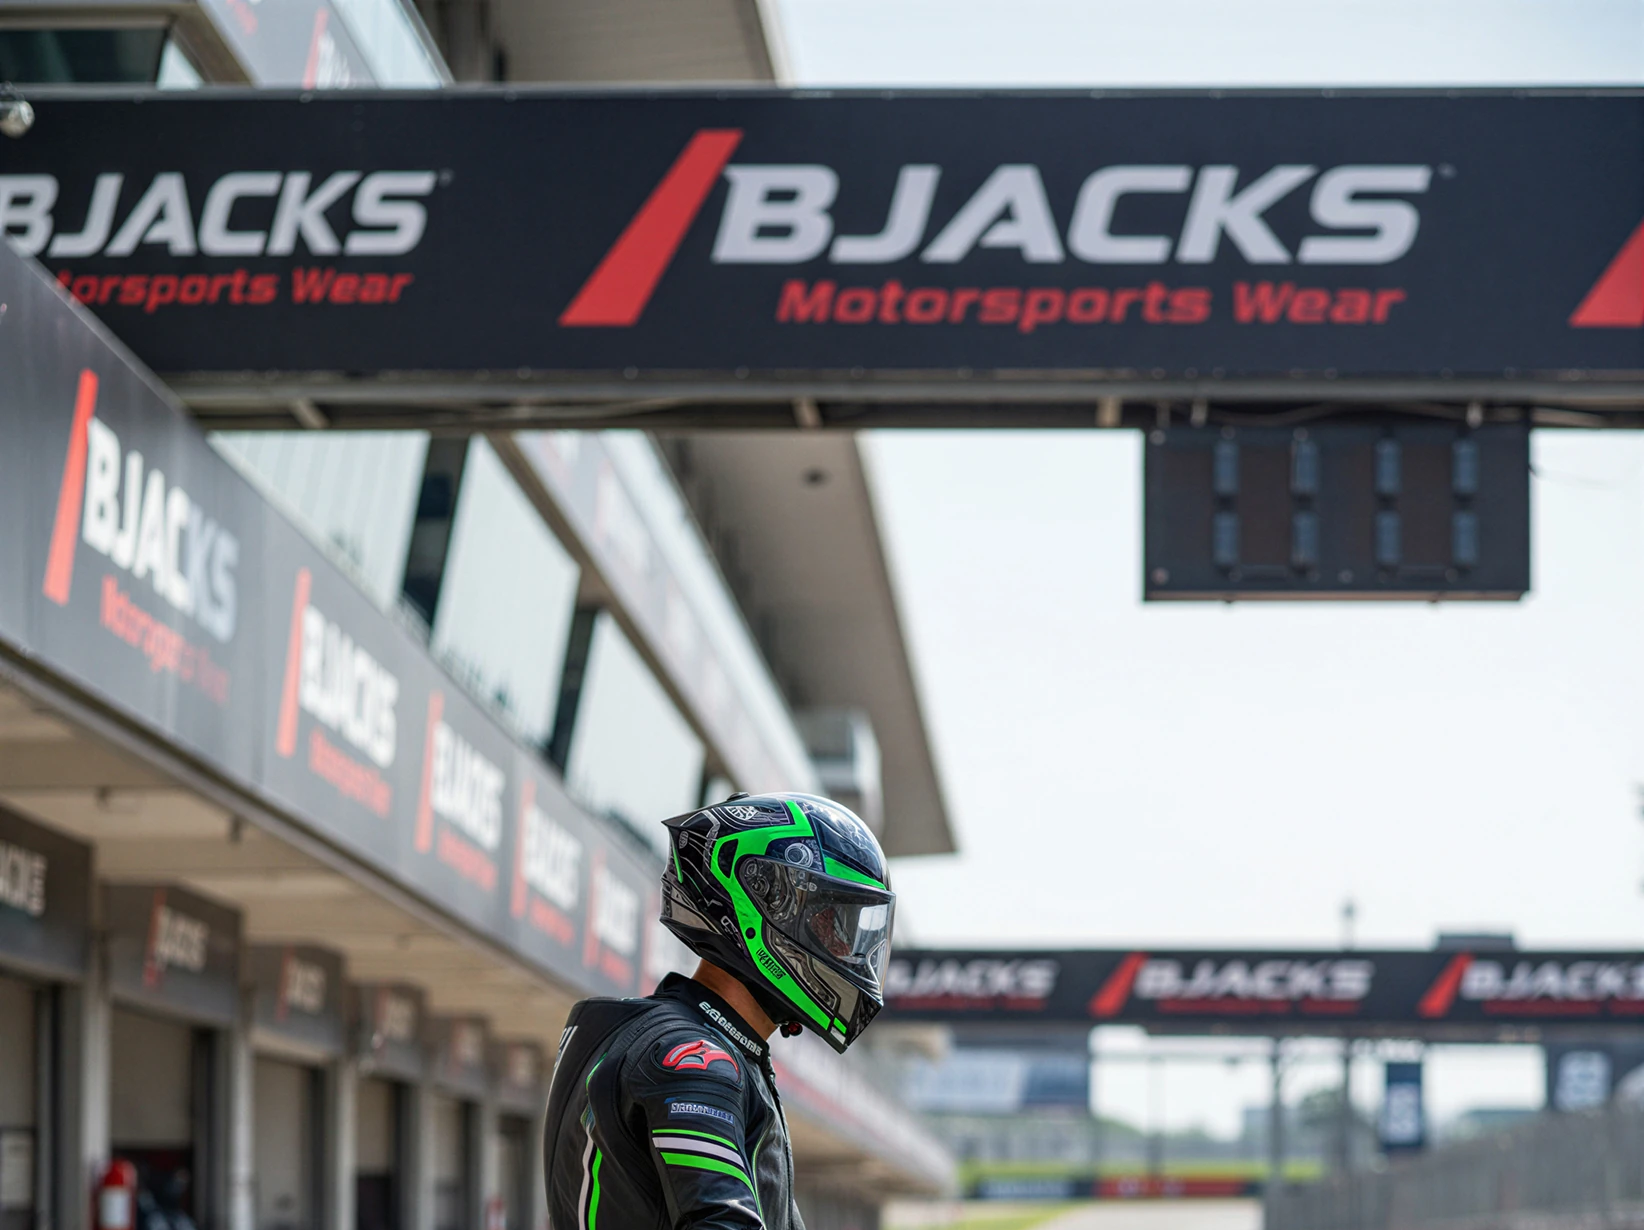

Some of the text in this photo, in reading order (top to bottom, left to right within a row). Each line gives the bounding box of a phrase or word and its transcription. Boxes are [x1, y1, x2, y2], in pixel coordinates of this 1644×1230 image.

[714, 163, 1431, 264] BJACKS
[292, 268, 412, 304] Wear
[777, 280, 1405, 332] Motorsports Wear
[82, 415, 240, 643] BJACKS
[1134, 958, 1375, 1000] BJACKS
